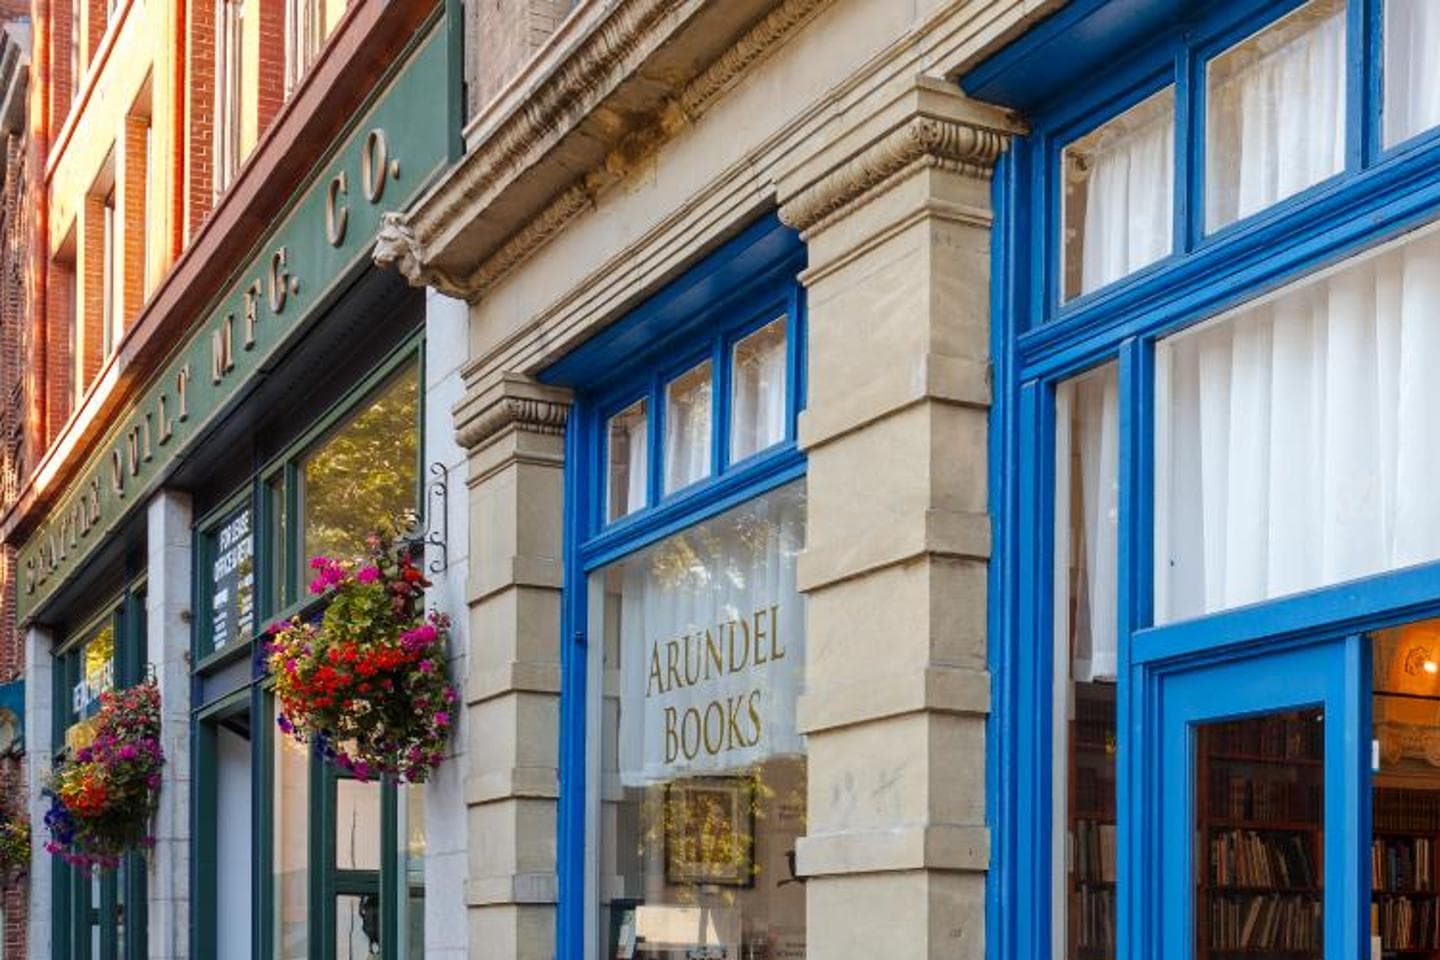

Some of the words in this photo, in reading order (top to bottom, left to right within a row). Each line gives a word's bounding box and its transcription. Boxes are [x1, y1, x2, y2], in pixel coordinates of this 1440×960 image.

[112, 363, 191, 499] QUILT
[212, 245, 299, 386] MFG.
[325, 127, 399, 249] CO.
[646, 604, 786, 698] ARUNDEL
[664, 688, 762, 764] BOOKS
